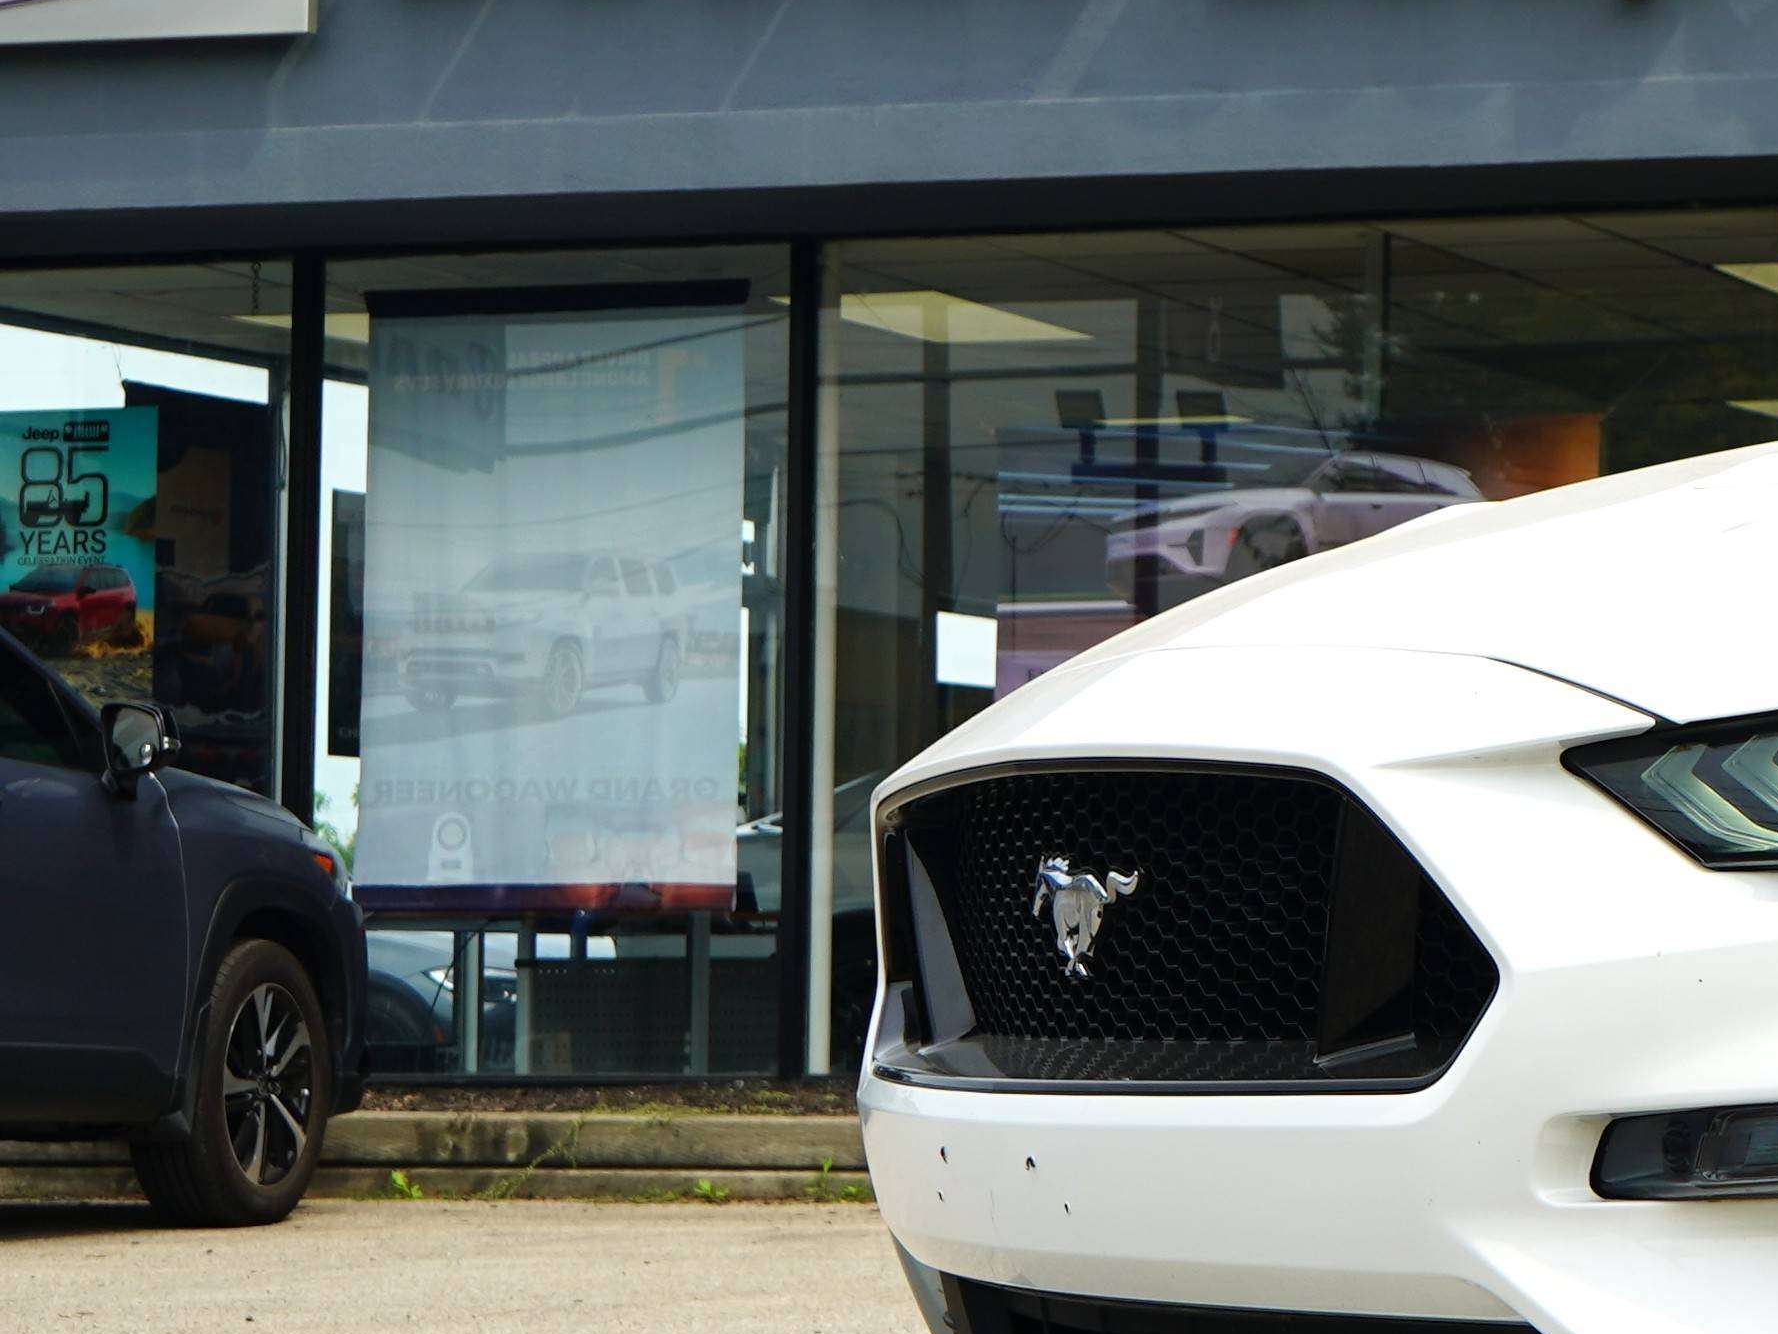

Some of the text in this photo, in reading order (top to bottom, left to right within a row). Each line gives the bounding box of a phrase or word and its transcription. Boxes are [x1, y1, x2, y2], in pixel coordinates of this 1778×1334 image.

[22, 426, 60, 442] Jeep
[19, 445, 109, 527] 85
[19, 529, 108, 555] YEARS
[78, 555, 106, 565] EVENT
